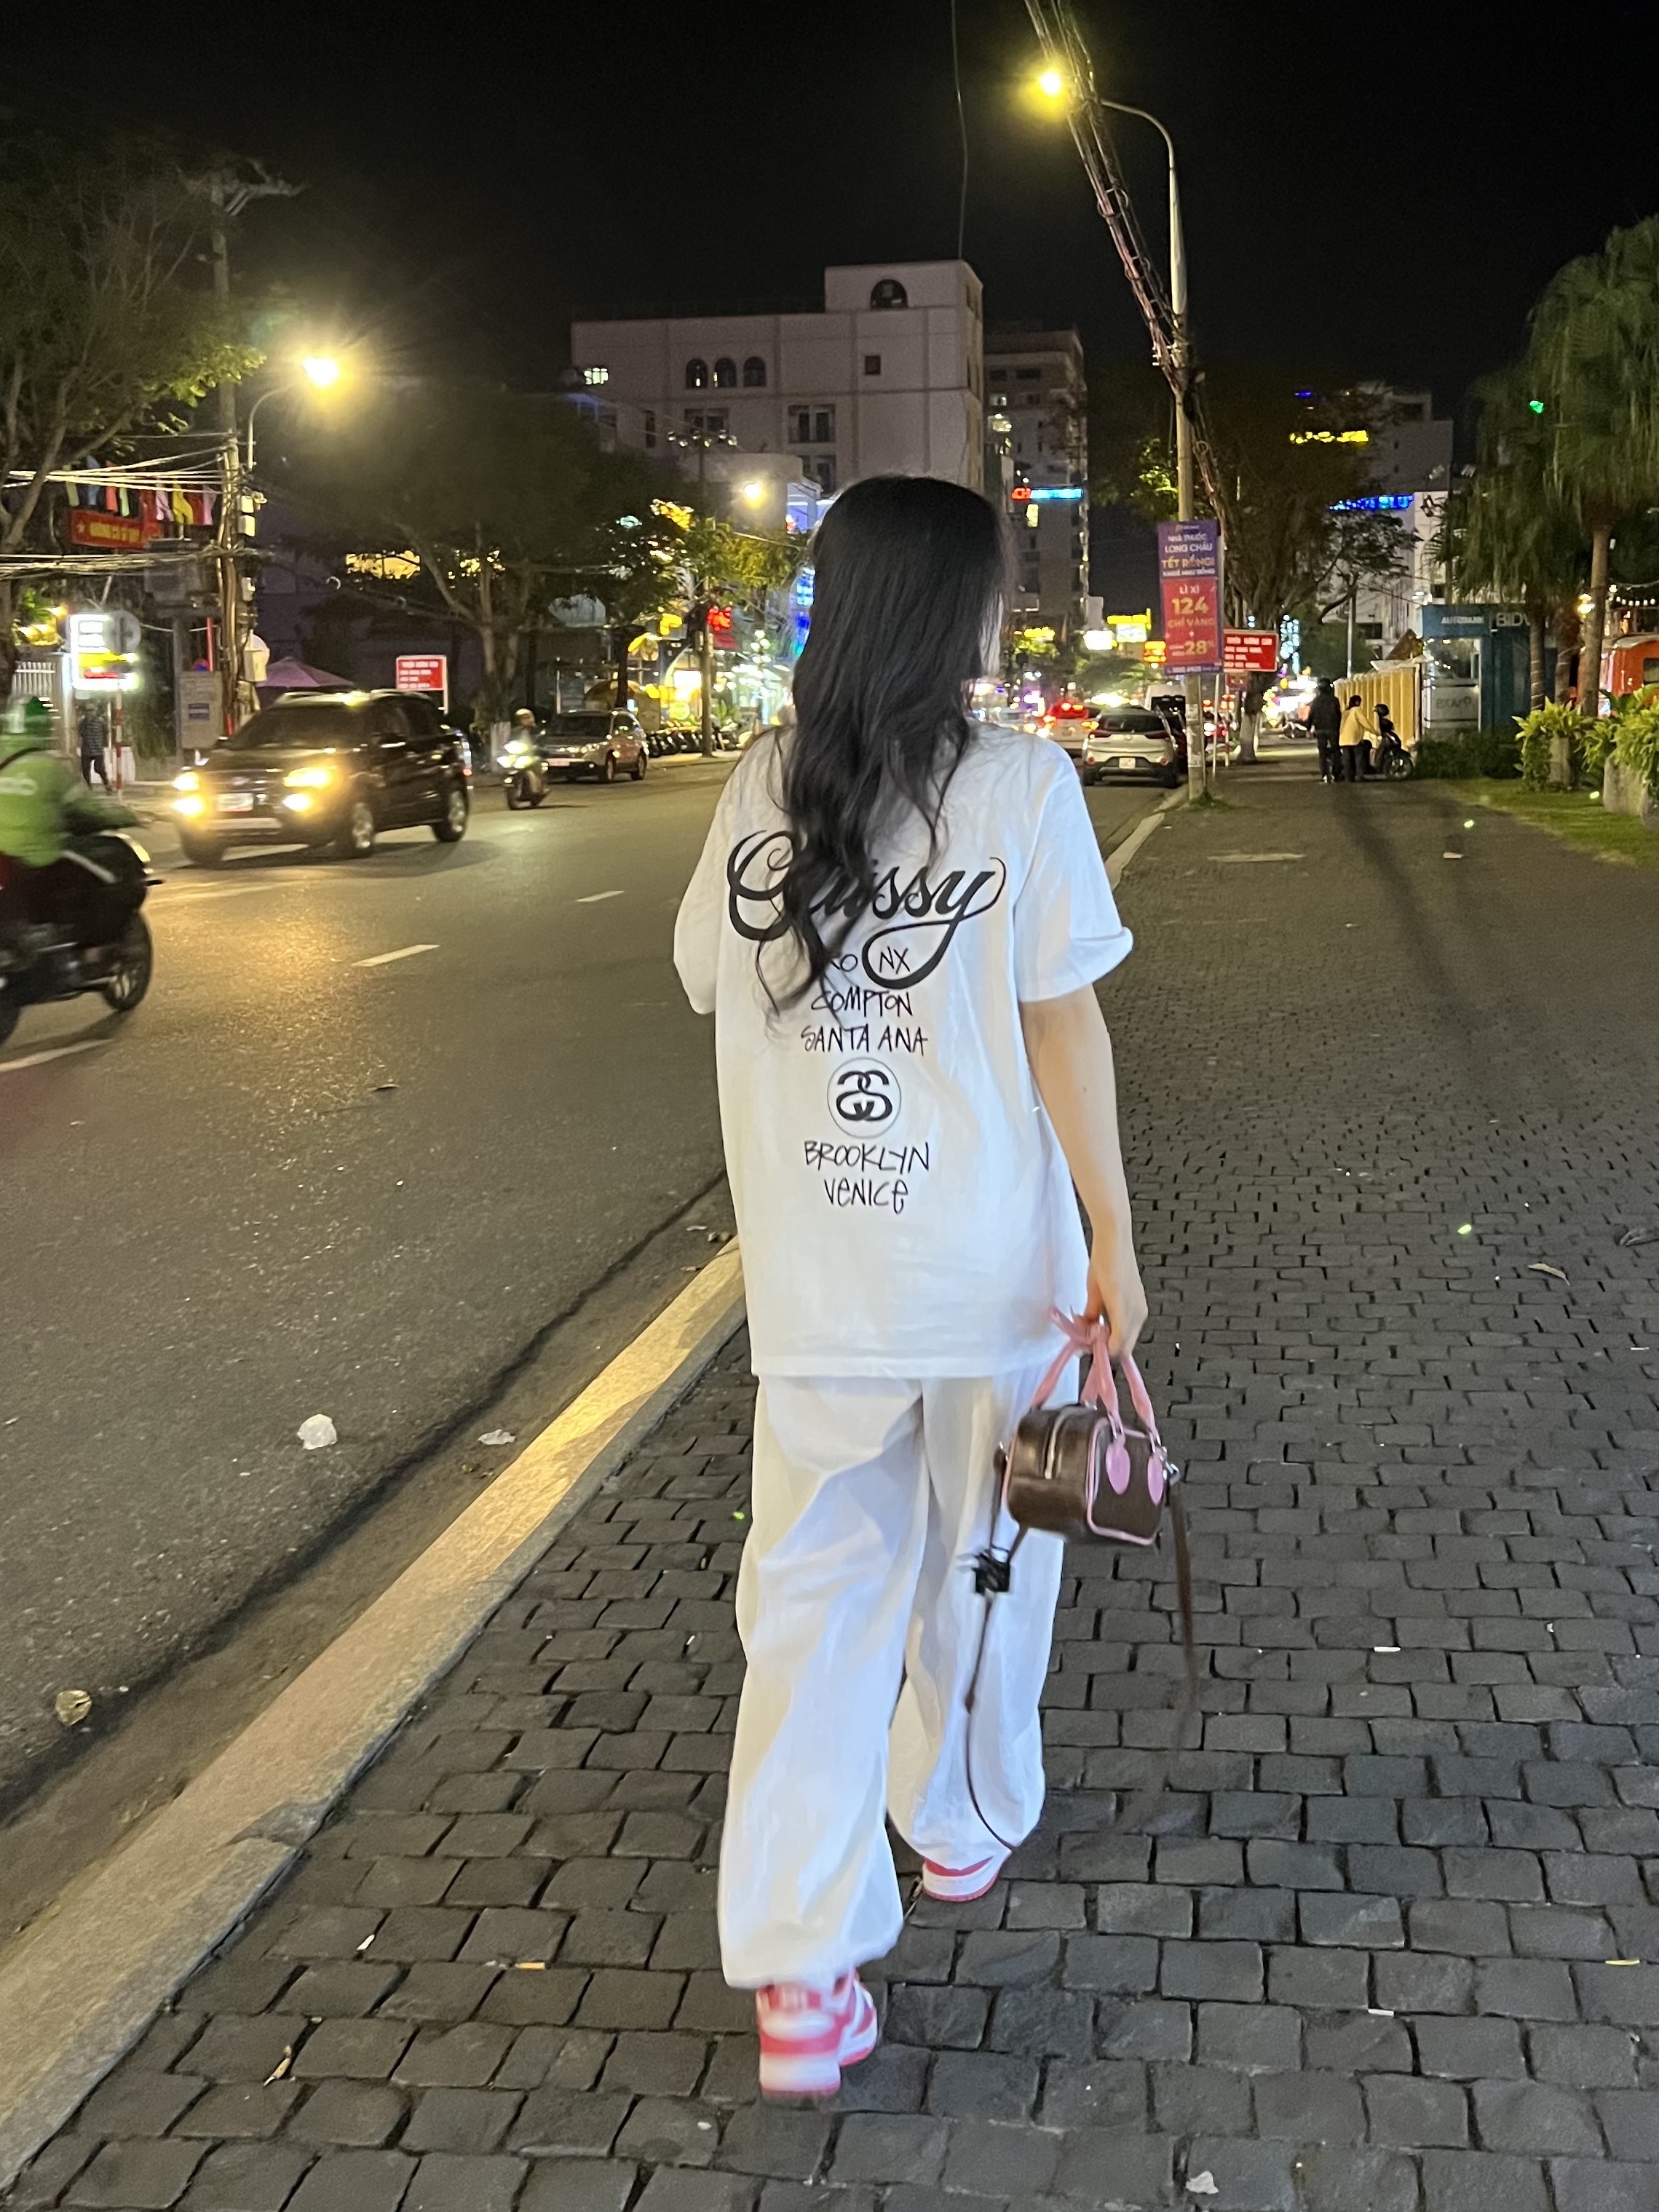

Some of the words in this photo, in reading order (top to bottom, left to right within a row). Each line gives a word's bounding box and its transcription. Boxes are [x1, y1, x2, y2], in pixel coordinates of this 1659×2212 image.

[1165, 544, 1188, 553] LONG
[1161, 555, 1179, 568] TẾT
[1171, 596, 1209, 615] 124
[811, 986, 913, 1018] COMPTON
[801, 1023, 870, 1054] SANTA
[877, 1024, 928, 1057] ANA
[804, 1141, 930, 1175] BROOKLYN
